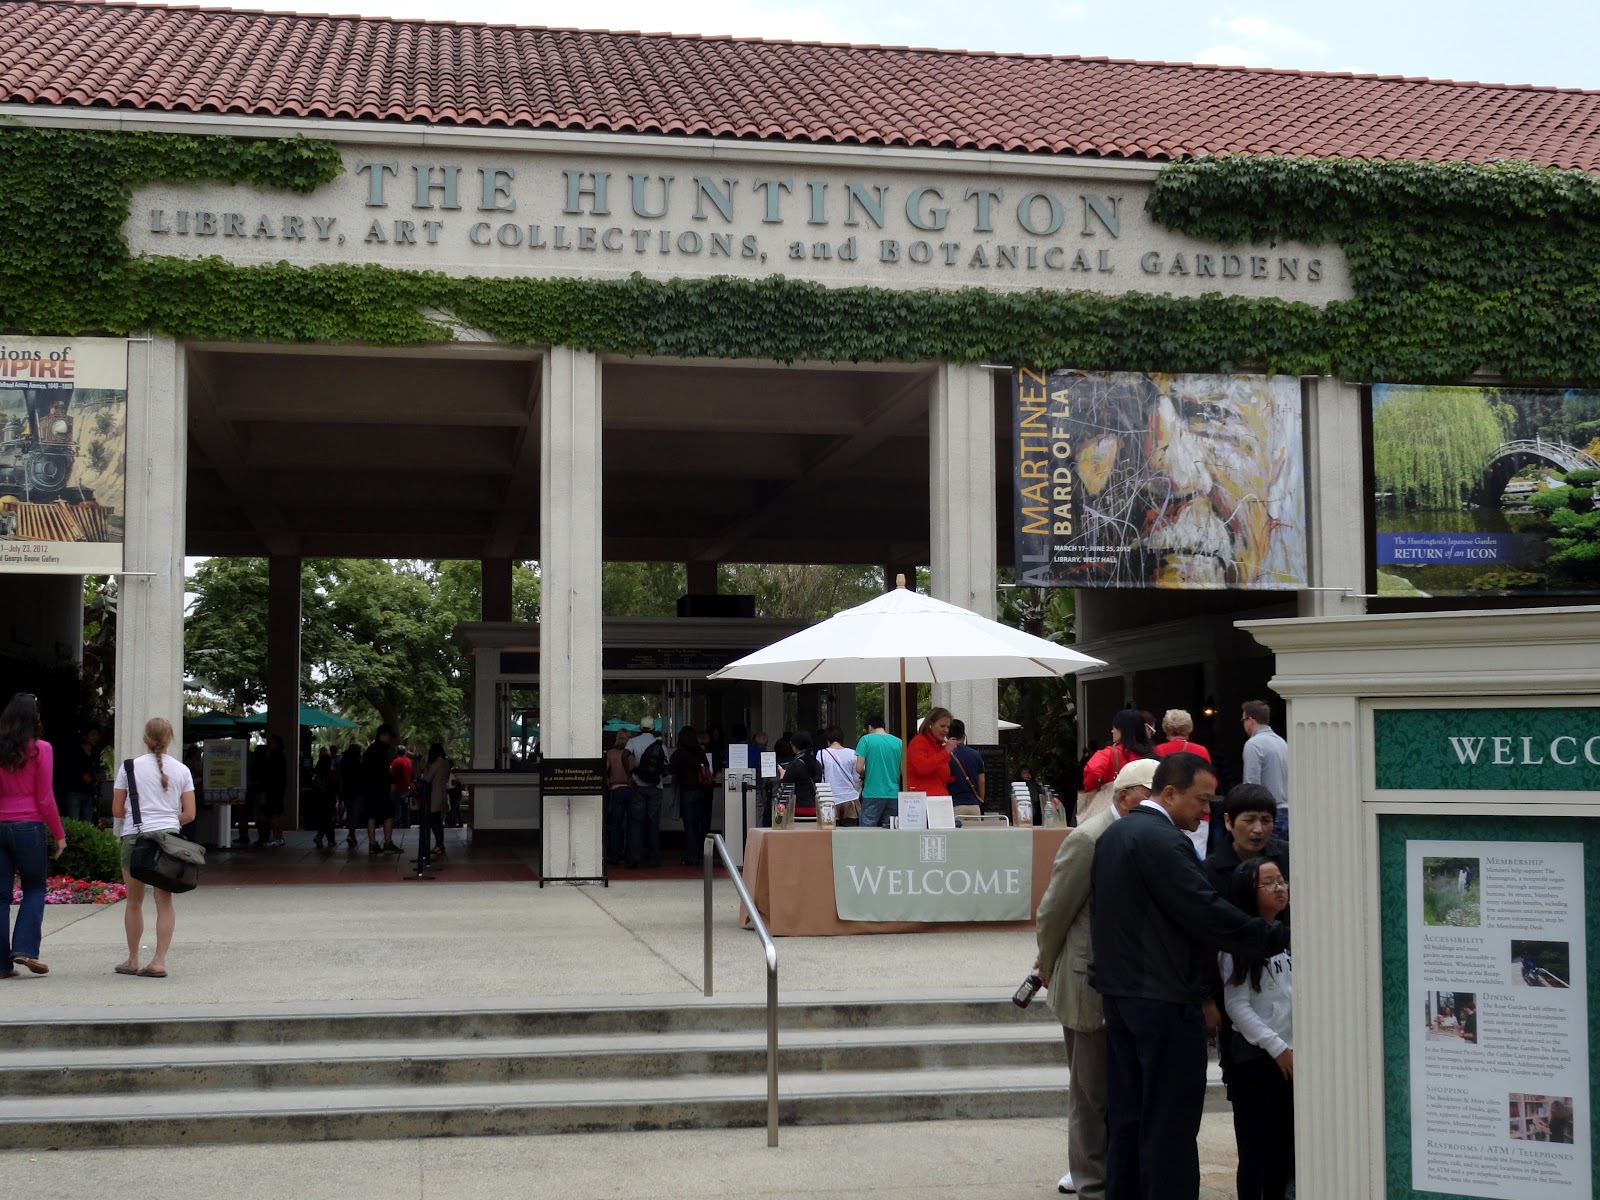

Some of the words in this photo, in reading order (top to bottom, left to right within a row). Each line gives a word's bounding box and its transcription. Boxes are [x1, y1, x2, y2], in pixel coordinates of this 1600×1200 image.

[355, 160, 517, 212] THE
[562, 170, 1123, 238] HUNTINGTON
[150, 208, 346, 245] LIBRARY,
[364, 219, 443, 244] ART
[469, 221, 768, 264] COLLECTIONS,
[788, 236, 859, 262] and
[880, 239, 1115, 274] BOTANICAL
[1140, 250, 1325, 282] GARDENS
[1, 345, 42, 361] ions
[49, 346, 72, 362] of
[1051, 389, 1070, 418] LA
[1018, 367, 1050, 535] MARTINEZ
[1052, 427, 1071, 460] OF
[1053, 467, 1072, 536] BARD
[33, 545, 48, 553] 2012
[1394, 536, 1406, 545] The
[1448, 537, 1473, 546] Japanese
[1474, 537, 1497, 545] Garden
[4, 555, 22, 563] George
[41, 555, 60, 564] Gallery
[1394, 548, 1443, 559] RETURN
[1445, 545, 1455, 559] of
[1466, 548, 1497, 559] ICON
[1486, 857, 1543, 865] MEMBERSHIP
[846, 865, 1020, 895] WELCOME
[1423, 934, 1483, 943] ACCESSIBILITY
[1482, 992, 1514, 1001] DINING
[1426, 1084, 1468, 1093] SHOPPING
[1427, 1140, 1477, 1151] RESTROOMS
[1487, 1146, 1508, 1154] ATM
[1519, 1148, 1574, 1160] TELEPHONES
